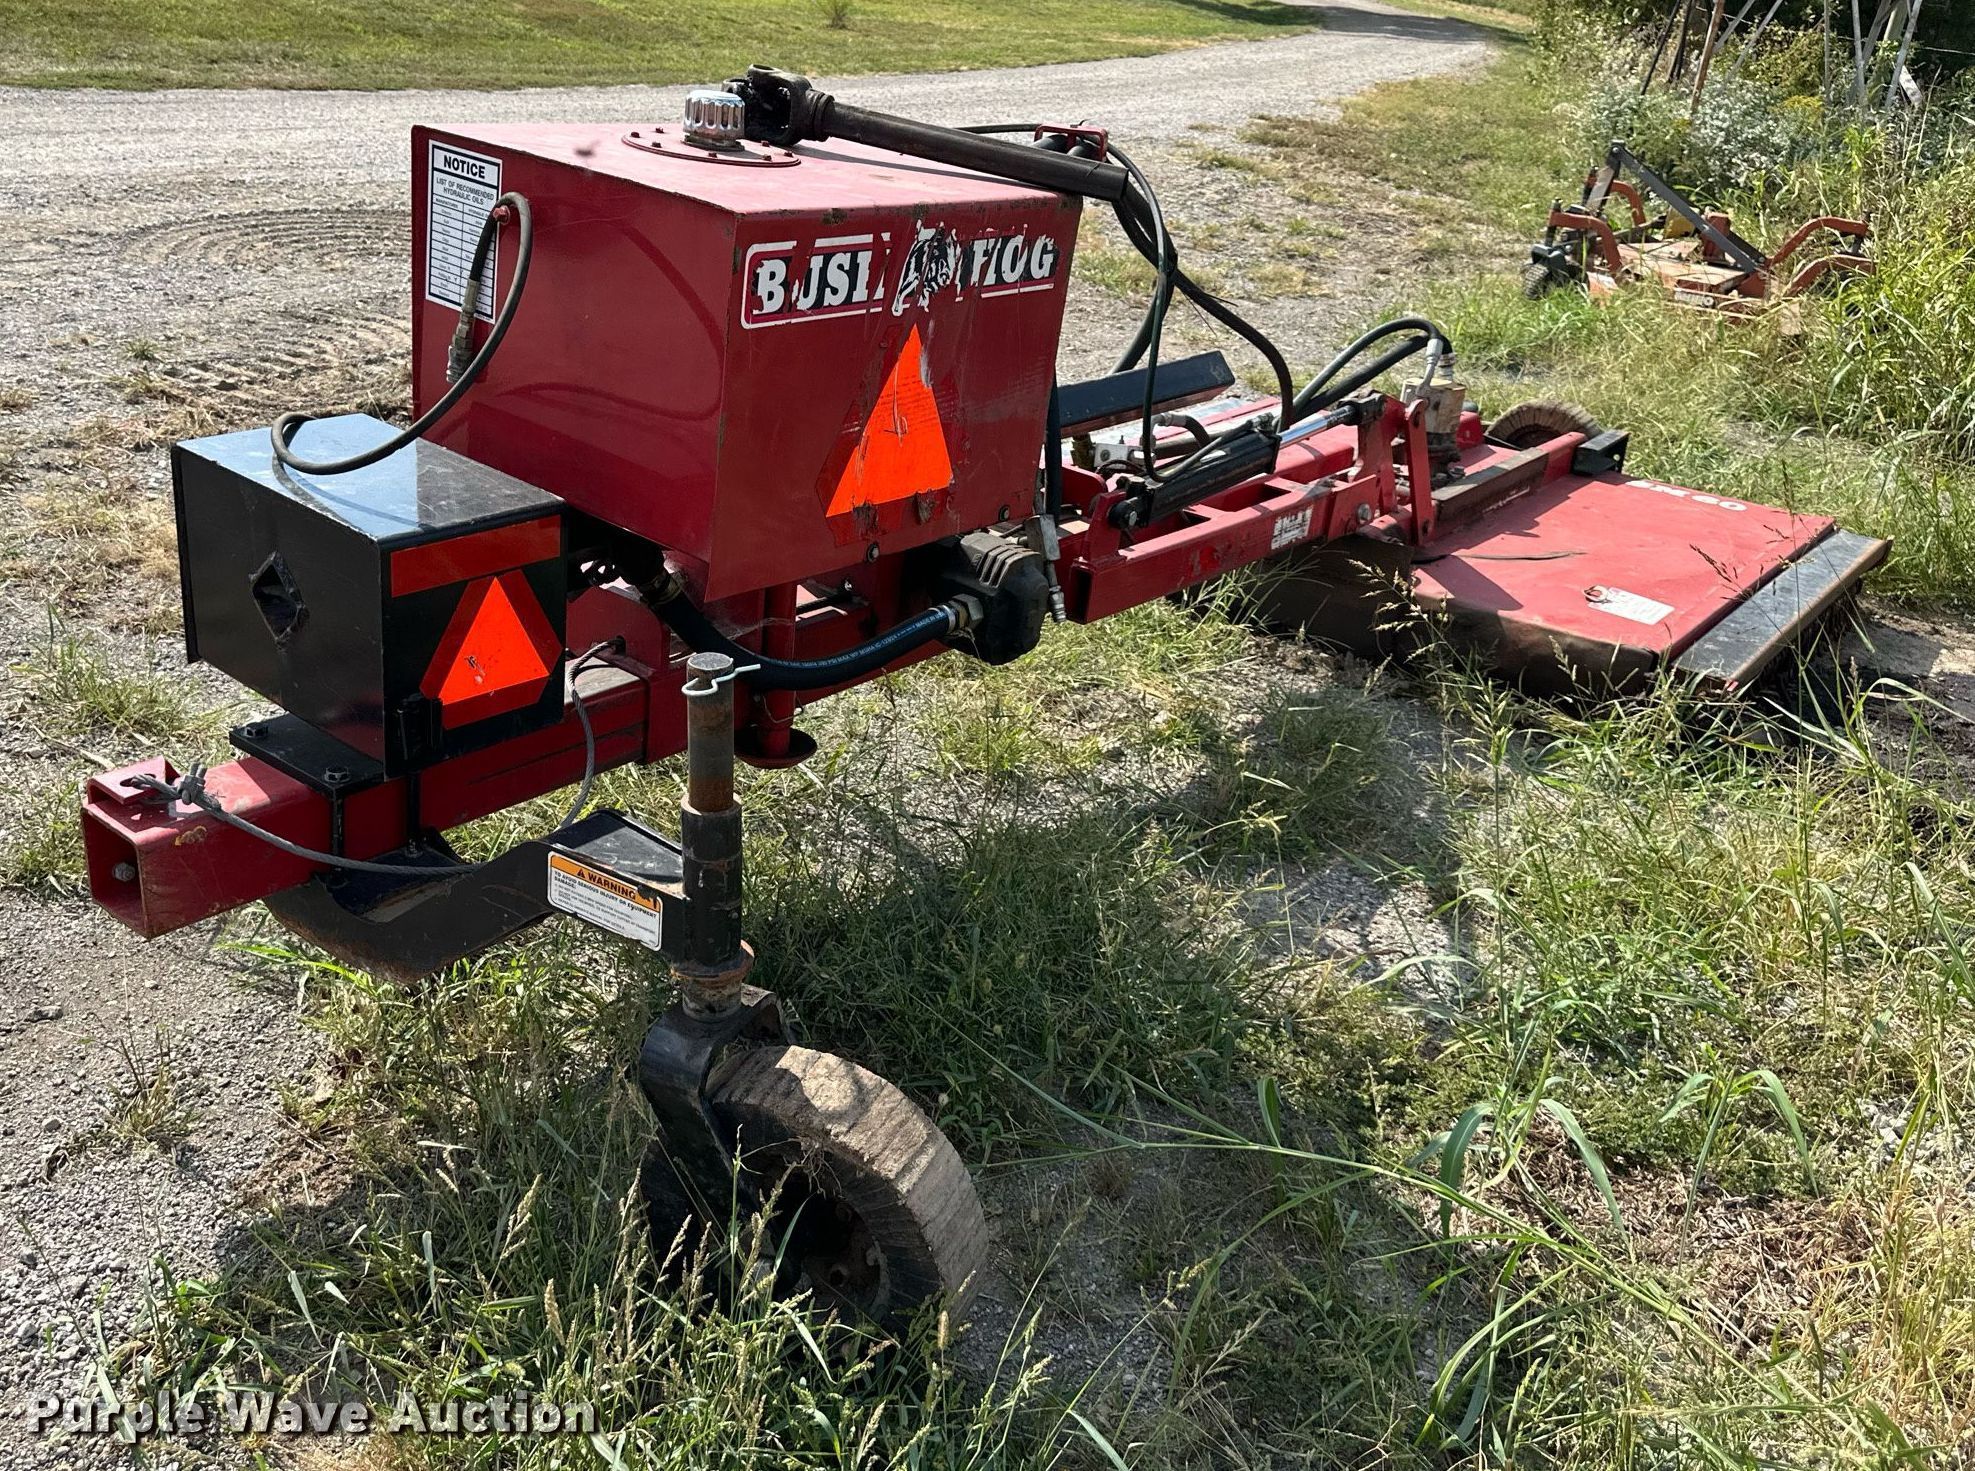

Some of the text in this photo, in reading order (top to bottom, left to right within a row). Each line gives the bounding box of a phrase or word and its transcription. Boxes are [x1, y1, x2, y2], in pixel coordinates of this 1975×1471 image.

[444, 154, 486, 180] NOTICE
[436, 176, 494, 200] LIST OF RECOMMENDED
[443, 186, 484, 205] HYDRAULIC OILS
[562, 875, 577, 885] AVOID
[578, 880, 600, 894] SERIOUS
[600, 890, 618, 902] INJURY
[627, 903, 657, 918] EQUIPMENT
[588, 872, 637, 900] WARNING
